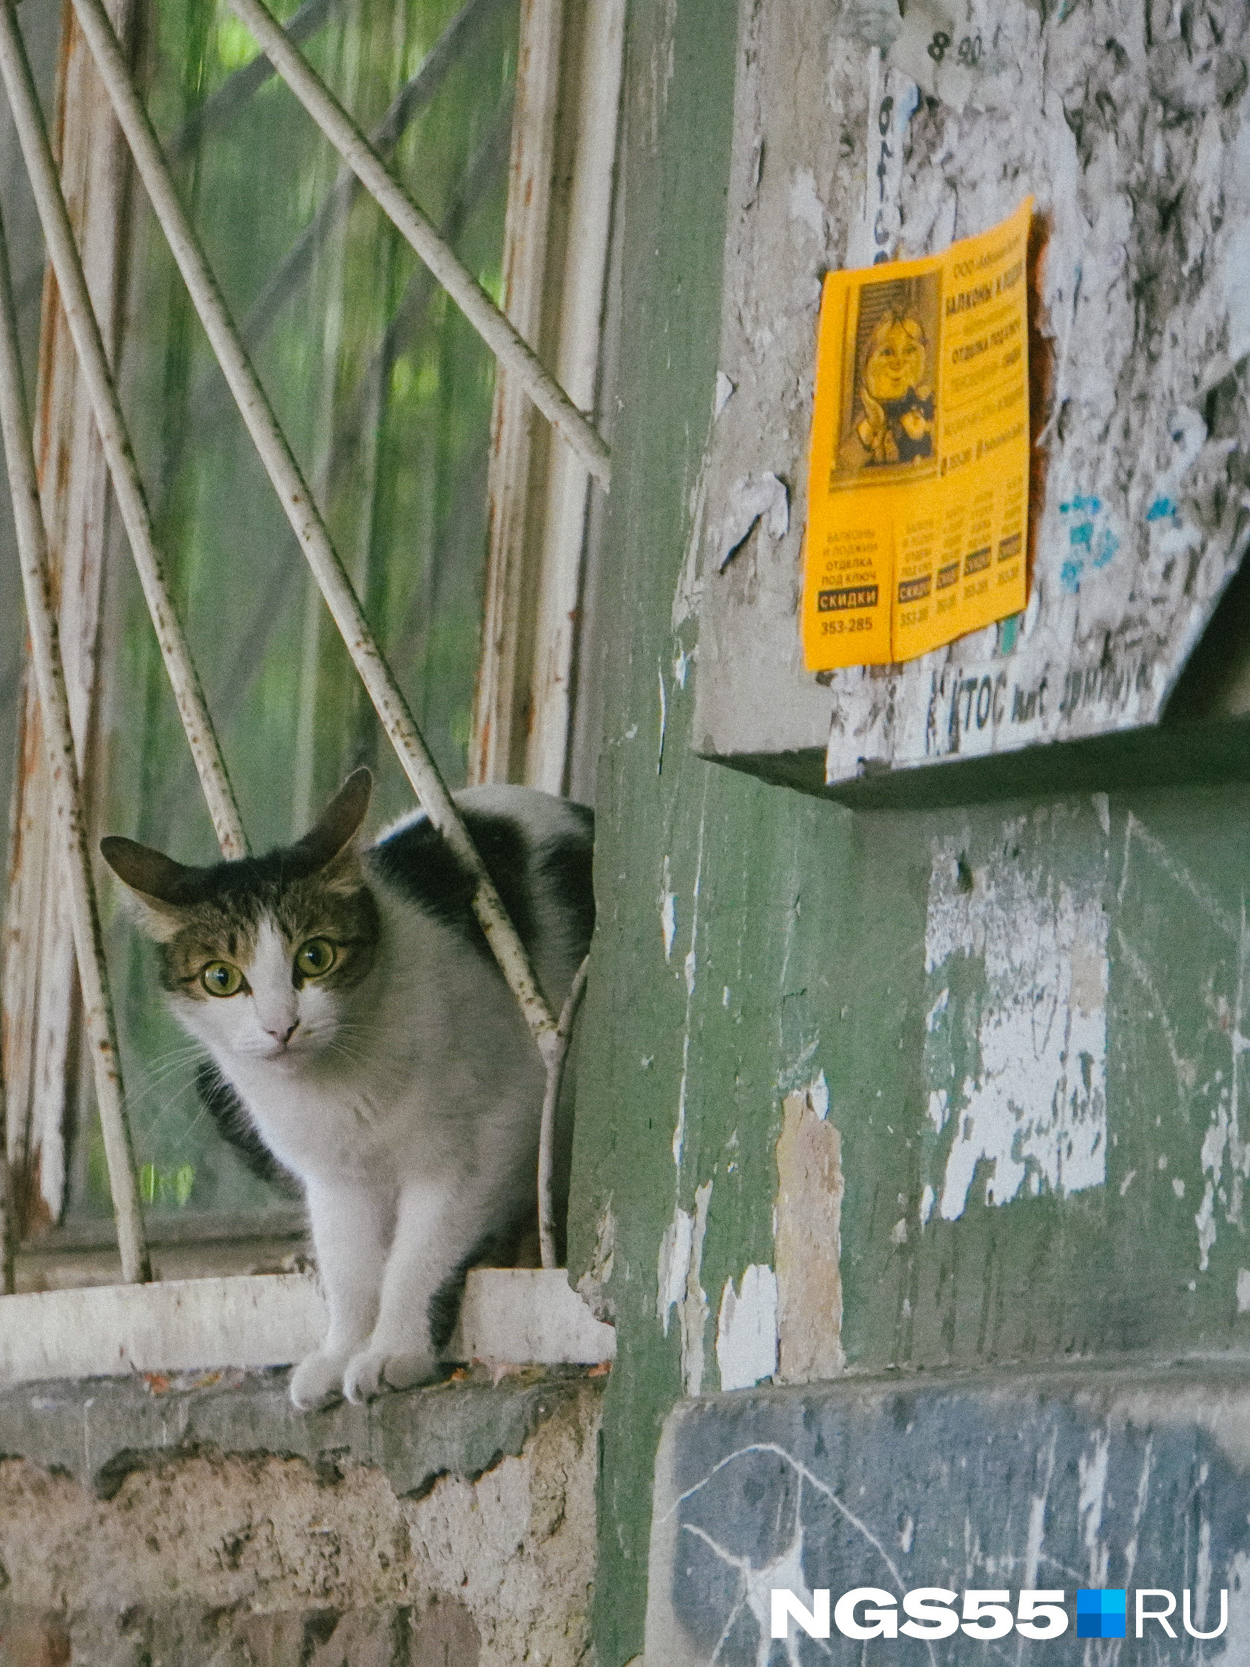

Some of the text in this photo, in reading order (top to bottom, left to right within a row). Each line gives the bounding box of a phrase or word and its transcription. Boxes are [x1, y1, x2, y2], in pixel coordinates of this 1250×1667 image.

[826, 557, 873, 572] ОТДЕЛКА
[821, 570, 877, 587] ПОД КЛЮЧ
[819, 589, 877, 609] СКИДКИ
[821, 616, 873, 636] 353-285
